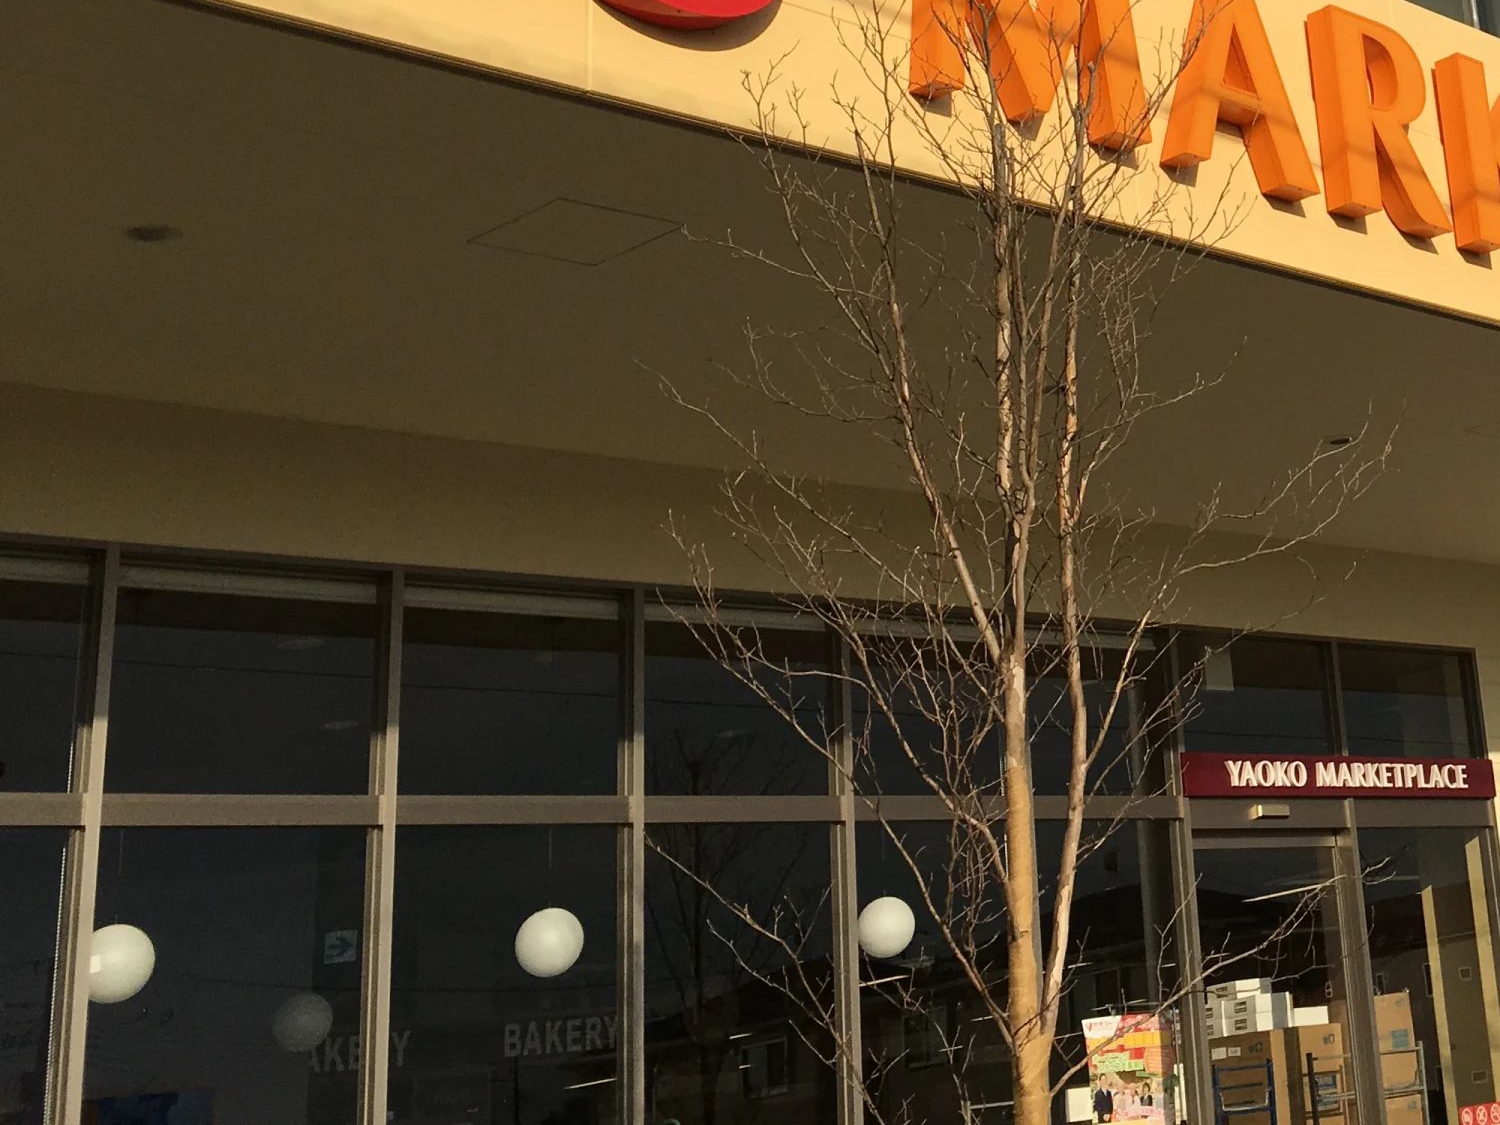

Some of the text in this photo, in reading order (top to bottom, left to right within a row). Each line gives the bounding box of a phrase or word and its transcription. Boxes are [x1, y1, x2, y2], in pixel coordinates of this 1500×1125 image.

[1224, 760, 1469, 789] YAOKO MARKETPLACE
[503, 1015, 618, 1058] BAKERY
